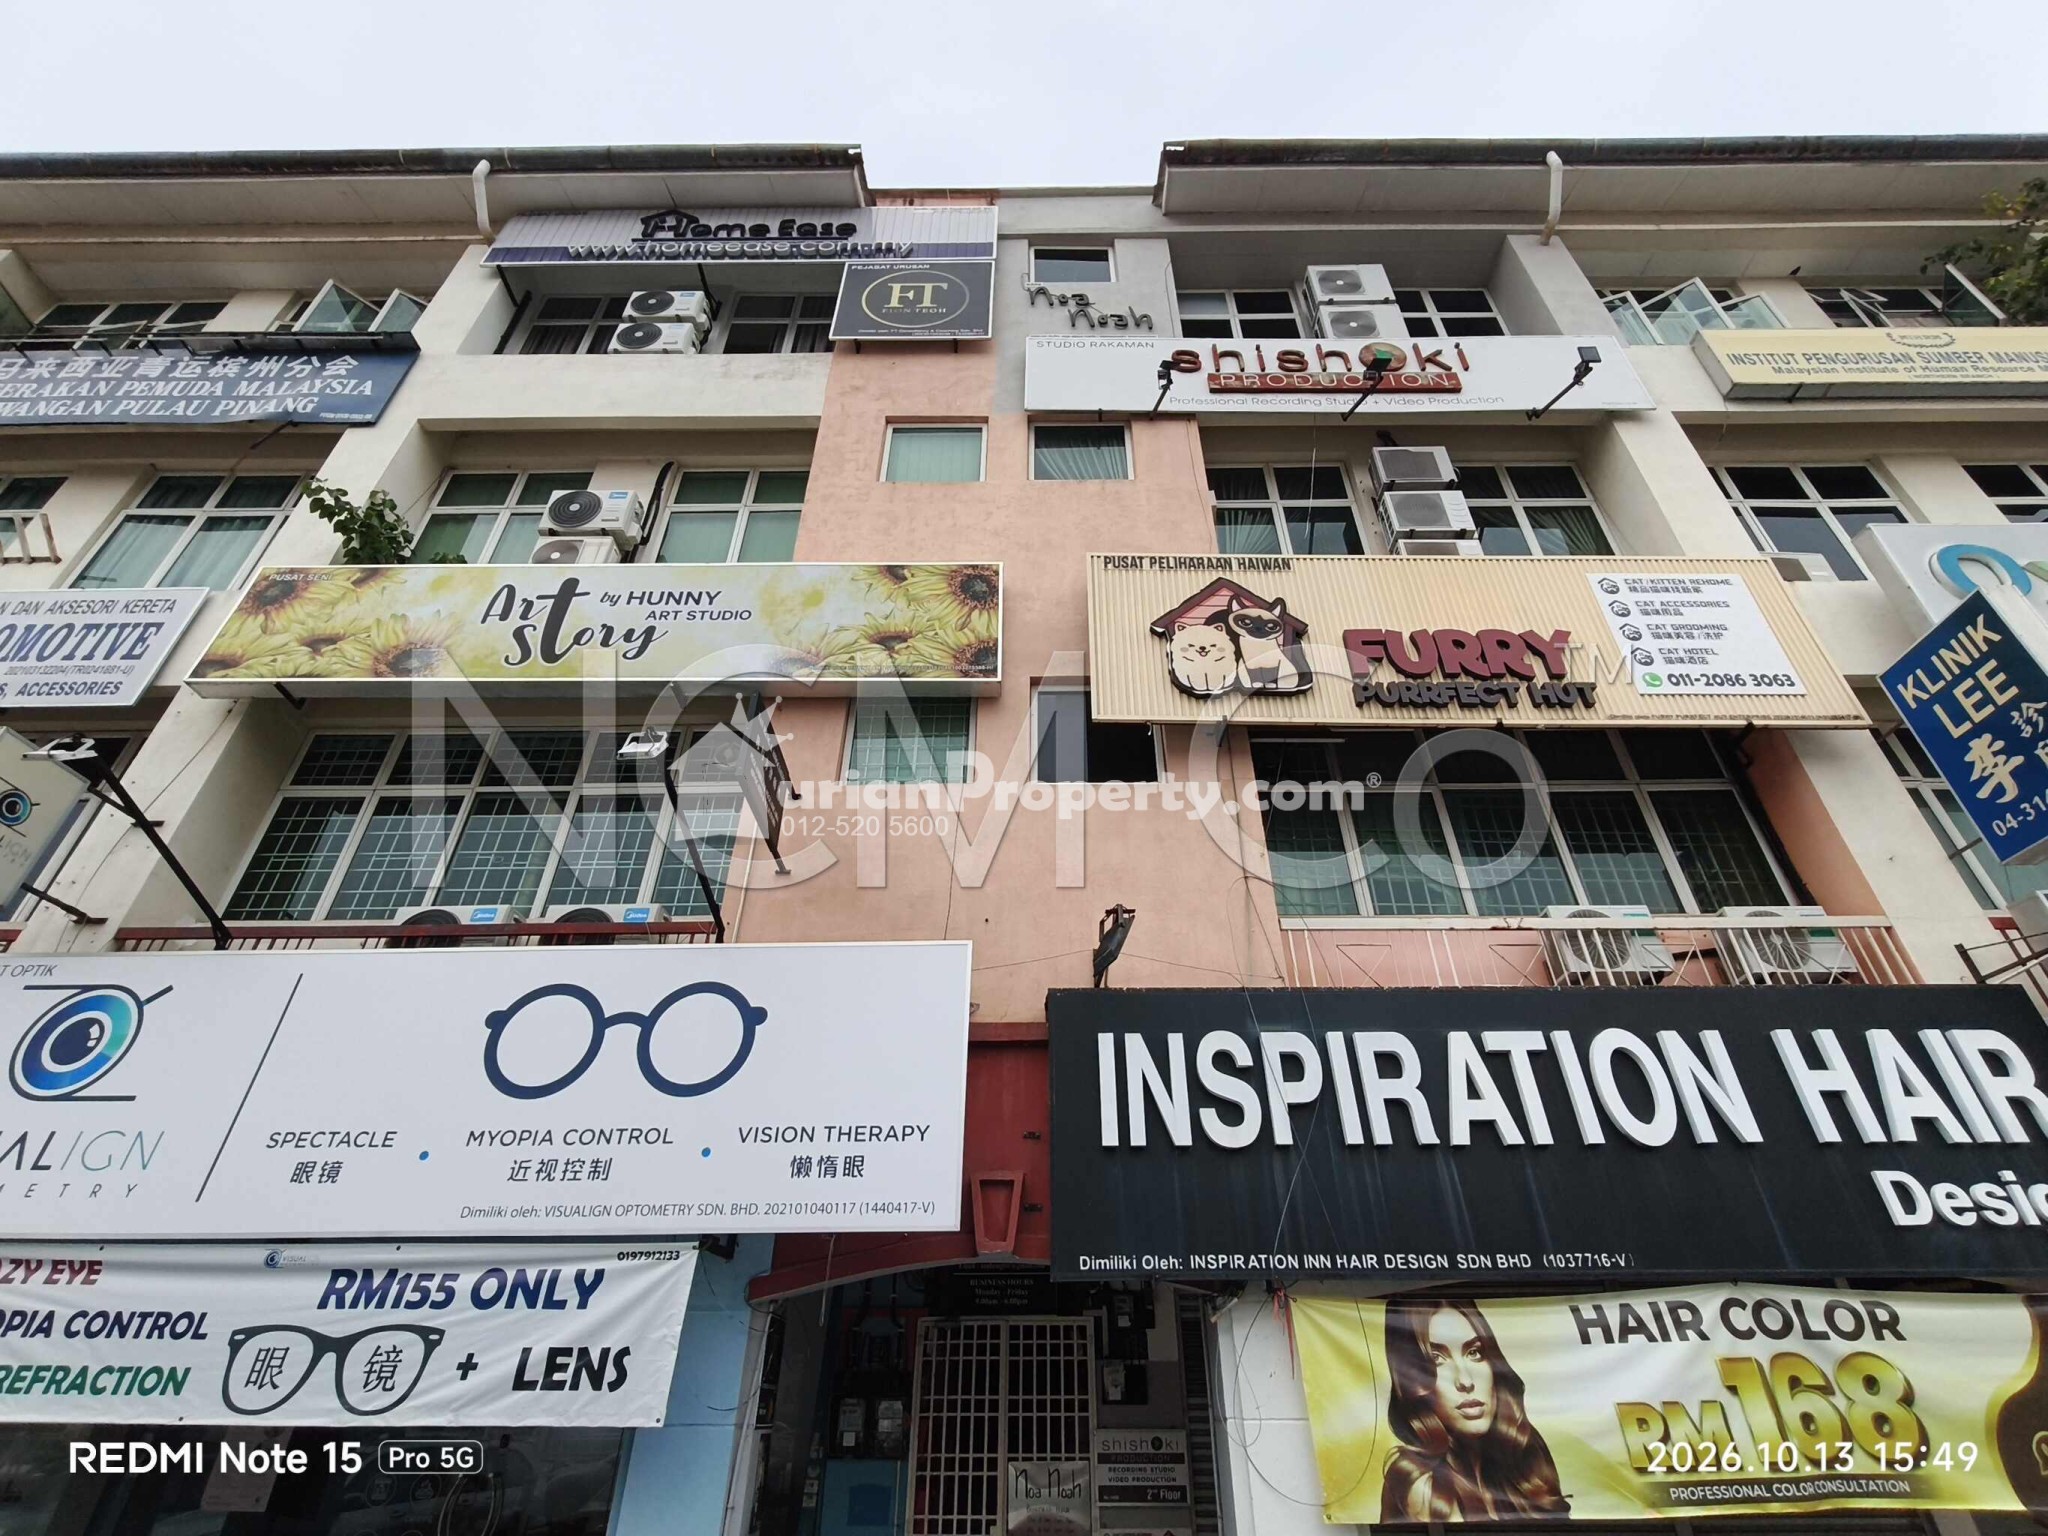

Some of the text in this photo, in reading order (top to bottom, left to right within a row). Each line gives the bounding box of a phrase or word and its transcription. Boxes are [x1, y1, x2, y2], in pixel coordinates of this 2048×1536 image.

[568, 240, 913, 258] www.homeease.com.my
[884, 282, 948, 308] FT
[1726, 352, 1800, 366] INSTITUT
[1801, 351, 1916, 365] PENGURUSAN
[1916, 351, 1985, 364] SUMBER
[1771, 364, 2037, 376] Malaysian Institute of Human Resource
[0, 378, 373, 398] ERAKAN PEMUDA MALAYSIA
[1220, 374, 1450, 387] PRODUCION
[114, 400, 210, 416] PULAU
[217, 397, 320, 416] PINANG
[1169, 396, 1248, 406] Professional
[1252, 396, 1323, 406] Recording
[1382, 396, 1425, 405] Video
[1428, 396, 1505, 405] Production
[1102, 556, 1292, 571] PUSAT PELIHARAAN HAIWAN
[269, 572, 305, 582] PUSAT
[10, 600, 46, 615] DAN
[44, 600, 118, 615] AKSESORI
[119, 599, 178, 614] KERETA
[600, 591, 620, 607] by
[626, 590, 722, 606] HUNNY
[645, 609, 752, 621] ART STUDIO
[1670, 624, 1728, 632] GROOMING
[1343, 628, 1572, 681] FURRY
[1683, 648, 1720, 656] HOTEL
[1896, 613, 2002, 709] KLINIK
[15, 681, 124, 696] ACCESSORIES
[1667, 672, 1796, 688] 011-2086 3063
[1352, 681, 1597, 709] PURRFECT HUT
[1933, 659, 2020, 739] LEE
[1964, 733, 2025, 803] 李
[10, 965, 58, 978] OPTIK
[1098, 1028, 2048, 1148] INSPIRATION HAIR
[265, 1131, 398, 1149] SPECTACLE
[465, 1128, 674, 1147] MYOPIA CONTROL
[738, 1124, 931, 1144] VISION THERAPY
[0, 1130, 165, 1173] ALIGN
[289, 1160, 344, 1185] 眼镜
[506, 1157, 613, 1183] 近视控制
[789, 1154, 866, 1179] 懒惰眼
[0, 1183, 138, 1199] ETRY
[460, 1201, 936, 1219] Dimiliki oleh: VISUALIGN OPTOMETRY SDN. BHD. 202101040117 (1440417-V)
[617, 1250, 680, 1262] 0197912133
[1079, 1253, 1635, 1271] Dimiliki Oleh: INSPIRATION INN HAIR DESIGN SDN BHD (1037716-V)
[0, 1258, 103, 1285] ZY EYE
[316, 1267, 605, 1311] RM155 ONLY
[0, 1310, 209, 1340] PIA CONTROL
[1569, 1297, 1907, 1345] HAIR COLOR
[244, 1346, 290, 1390] 眼
[362, 1343, 403, 1394] 镜
[511, 1346, 631, 1393] LENS
[1160, 1488, 1181, 1500] Floor
[1669, 1482, 1771, 1501] PROFESSIONAL
